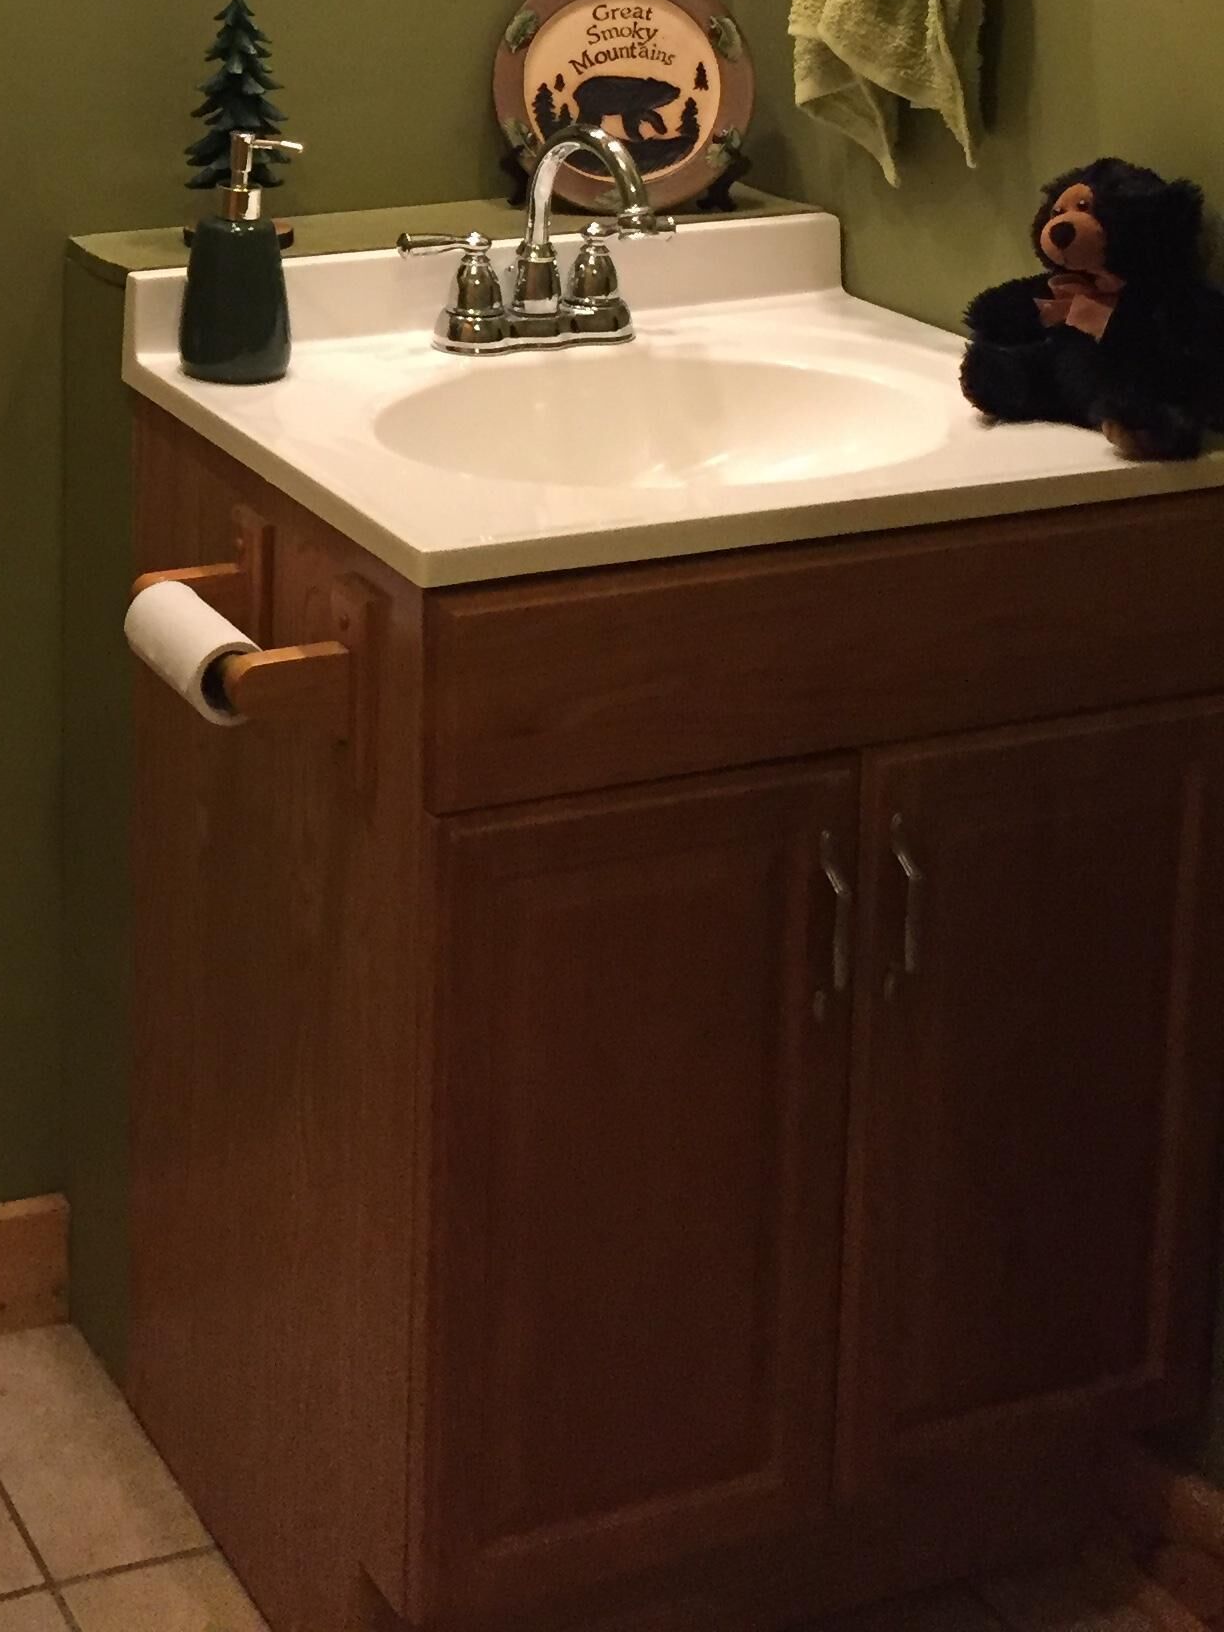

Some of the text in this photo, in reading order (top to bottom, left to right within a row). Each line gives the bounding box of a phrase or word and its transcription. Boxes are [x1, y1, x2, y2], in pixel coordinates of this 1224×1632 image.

[592, 4, 653, 21] Great
[586, 22, 658, 46] Smoky
[568, 42, 676, 75] Mountains
